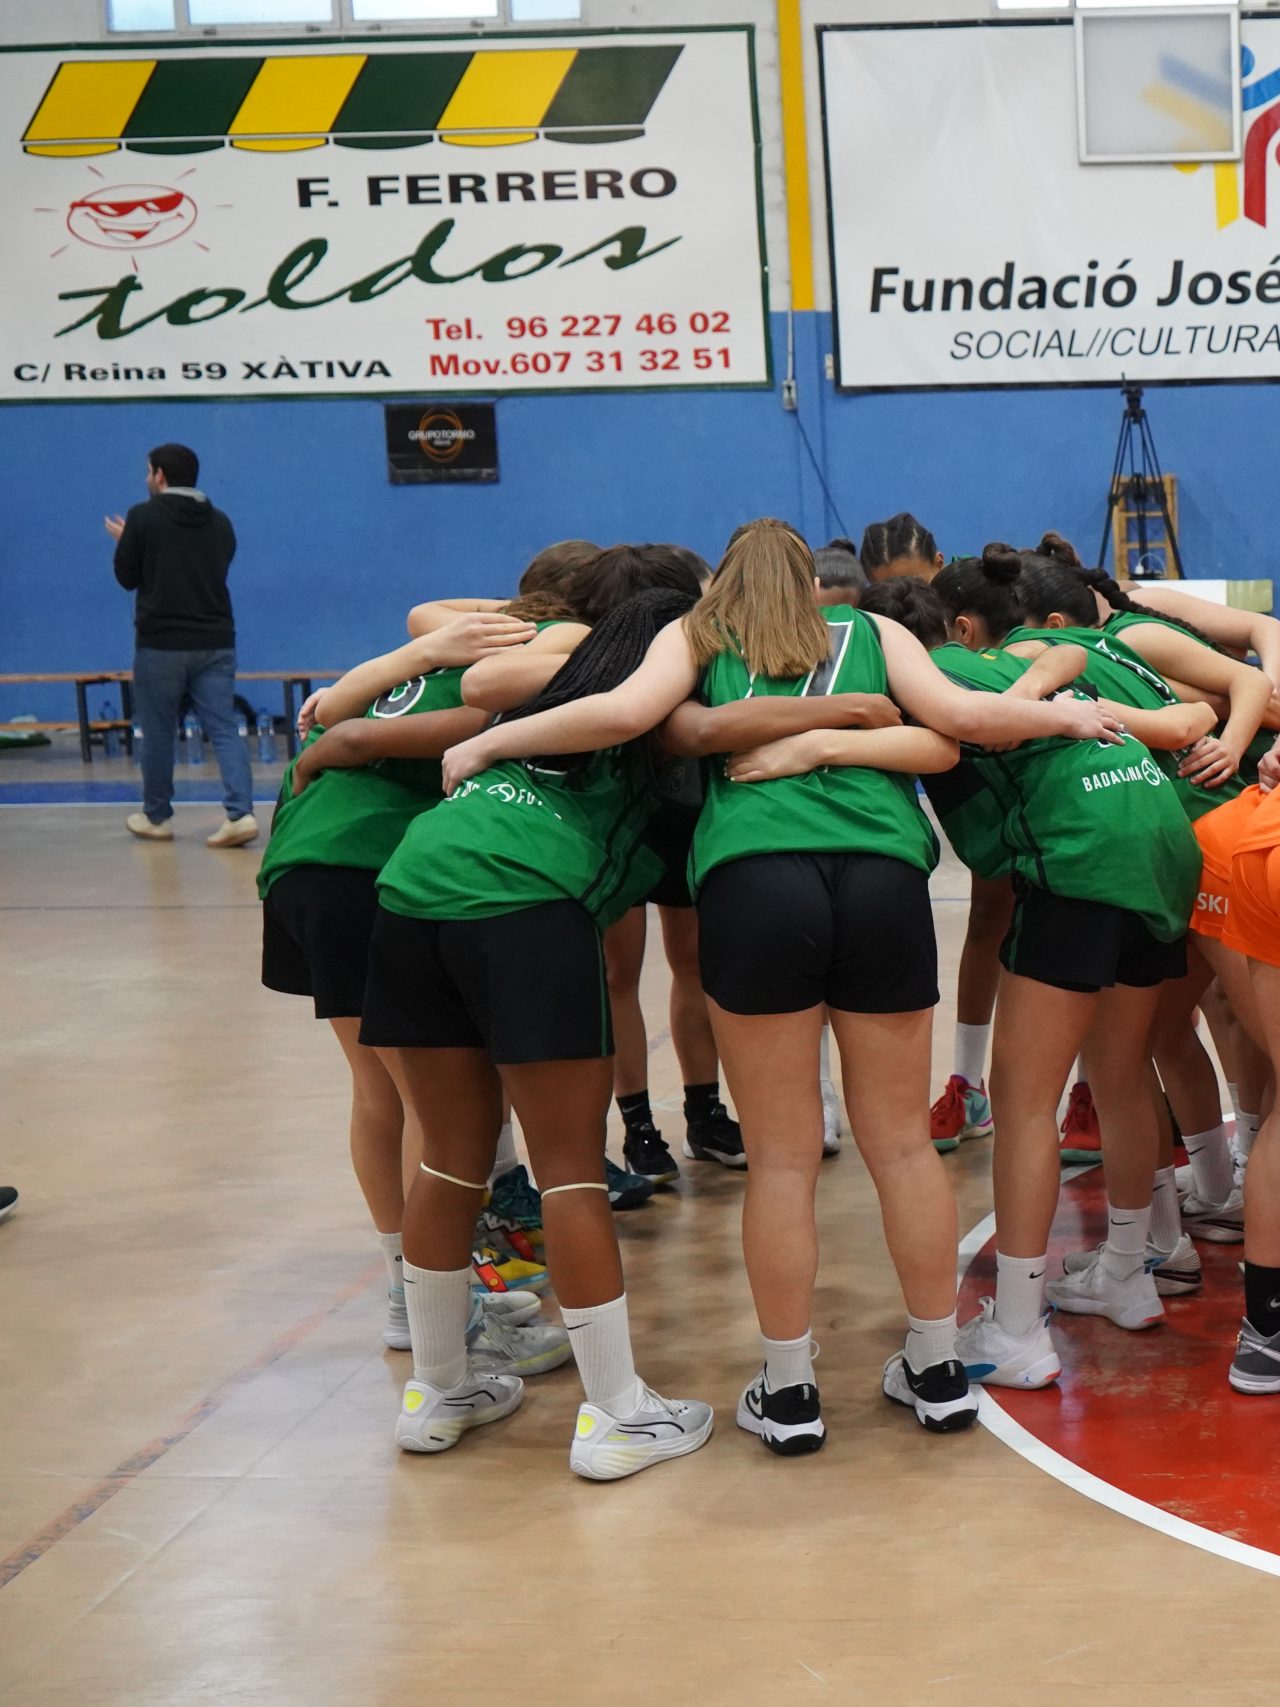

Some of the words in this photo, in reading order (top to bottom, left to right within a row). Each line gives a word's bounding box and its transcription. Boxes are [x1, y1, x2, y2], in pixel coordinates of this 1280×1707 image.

[297, 177, 340, 208] F.
[366, 166, 678, 207] FERRERO
[53, 217, 683, 340] toldos
[869, 258, 1138, 313] Fundació
[425, 317, 483, 341] Tel.
[506, 316, 548, 338] 96
[560, 314, 622, 337] 227
[635, 312, 677, 335] 46
[689, 311, 731, 333] 02
[13, 362, 51, 383] C/
[63, 362, 166, 382] Reina
[181, 361, 228, 381] 59
[241, 355, 392, 380] XÀTIVA
[586, 350, 623, 372] 31
[639, 348, 680, 371] 32
[692, 347, 731, 369] 51
